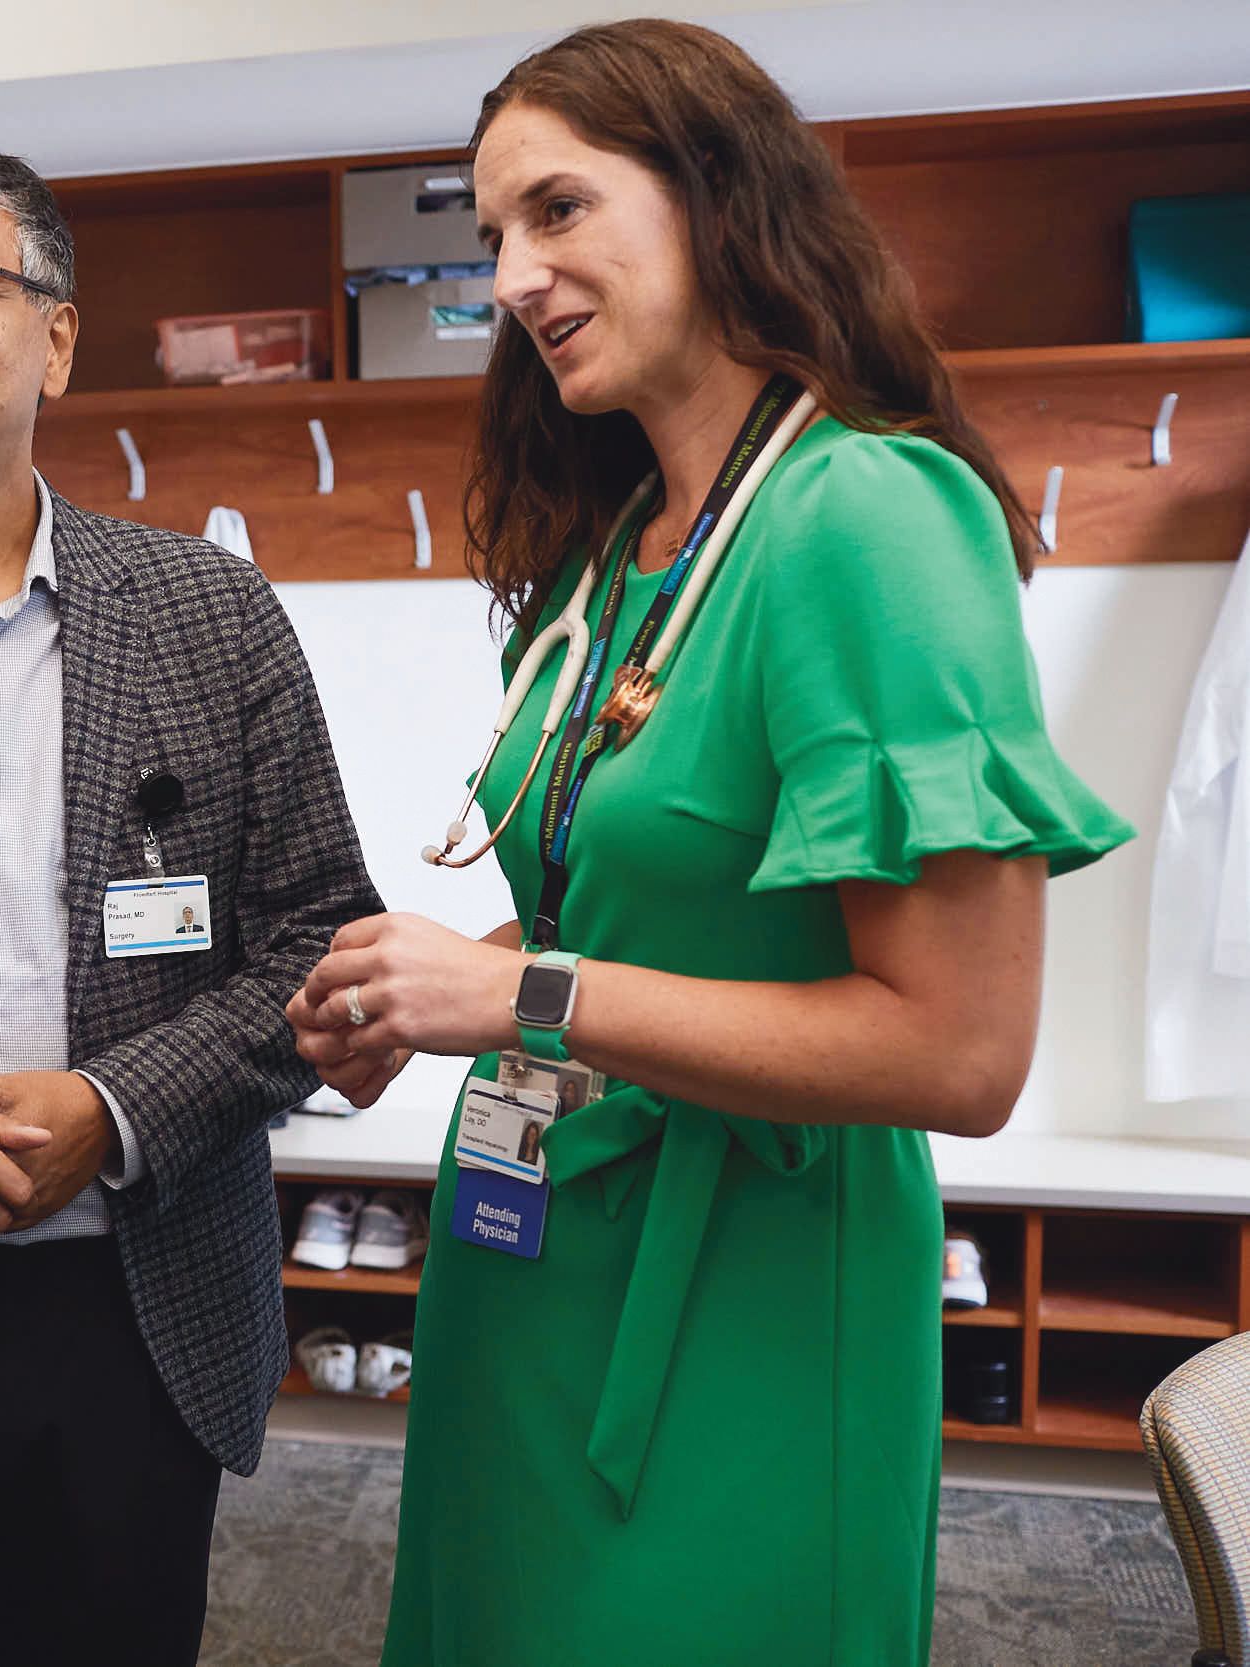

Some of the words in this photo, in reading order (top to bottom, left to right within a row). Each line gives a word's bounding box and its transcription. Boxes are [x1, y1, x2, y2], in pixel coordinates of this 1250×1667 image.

[747, 396, 780, 440] Moment
[721, 443, 753, 488] Matters
[544, 790, 559, 839] Moment
[553, 741, 572, 786] Matters
[109, 932, 135, 941] Surgery
[467, 1105, 490, 1118] Veronica
[476, 1201, 521, 1228] Attending
[473, 1218, 519, 1243] Physician
